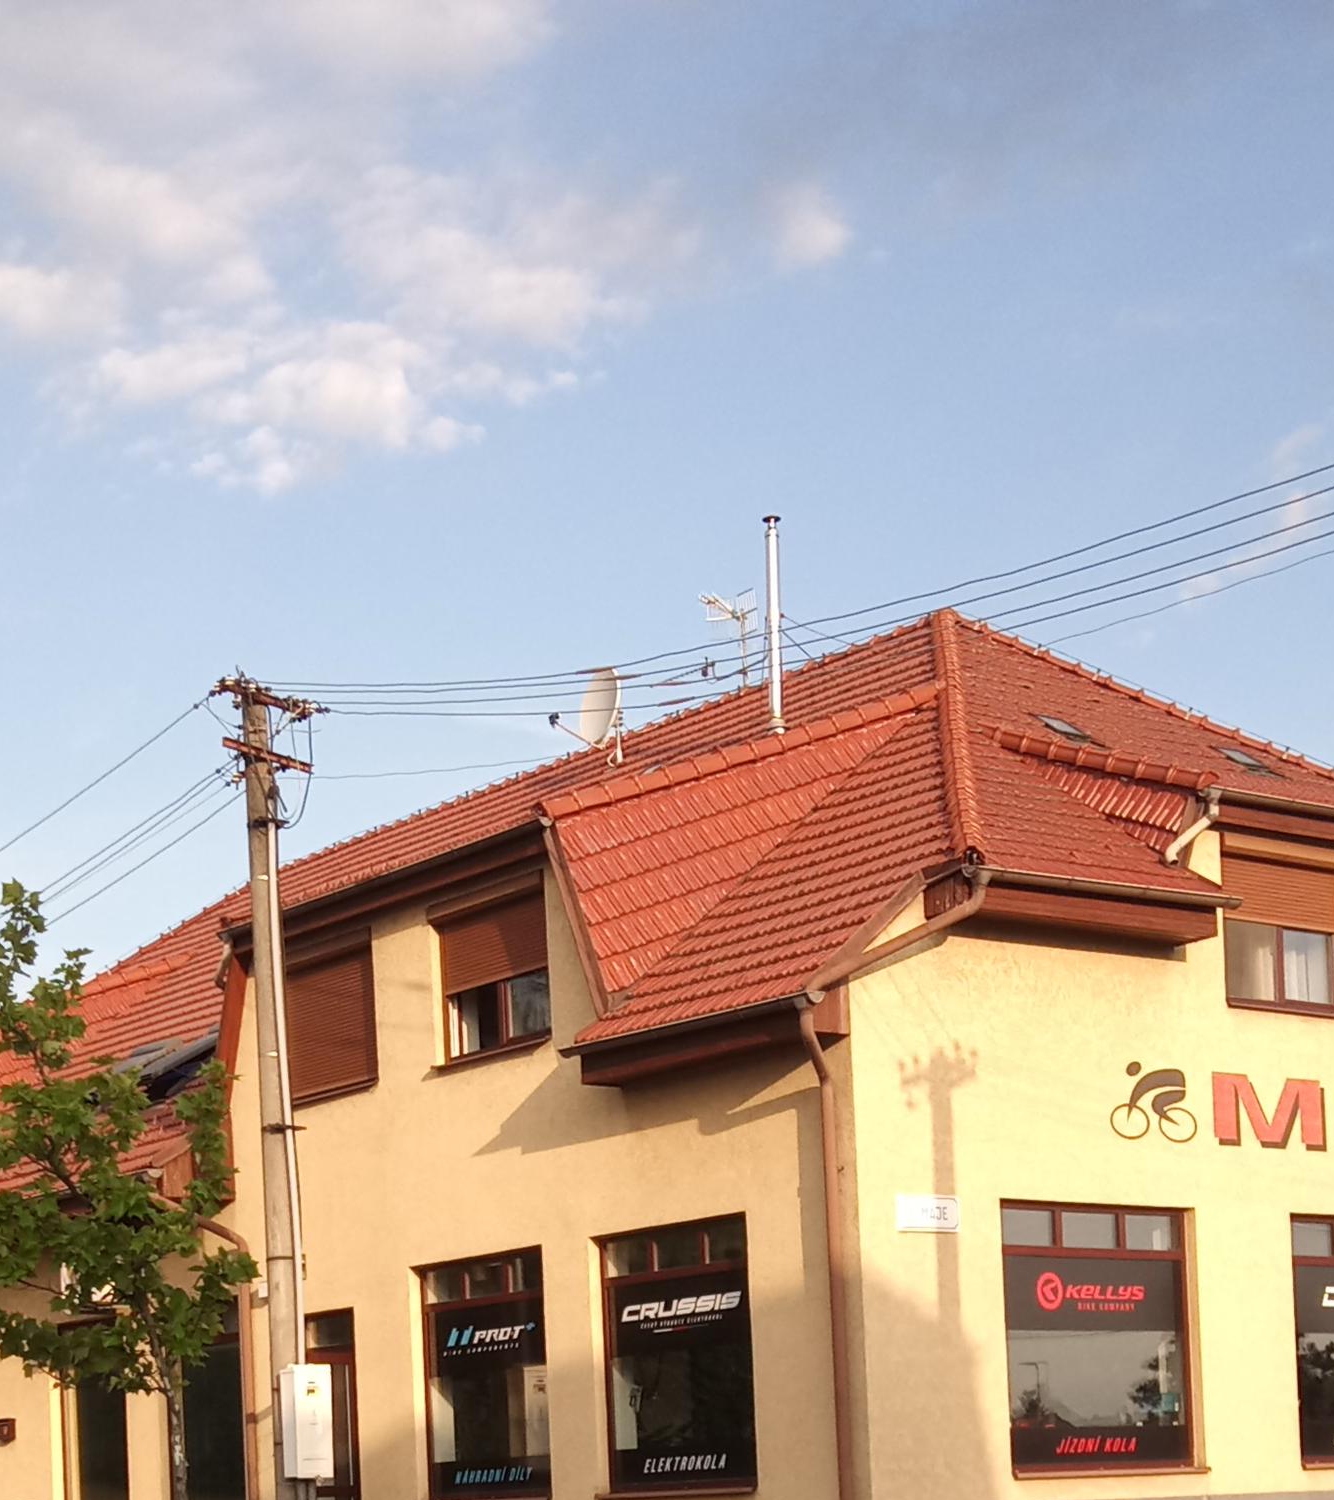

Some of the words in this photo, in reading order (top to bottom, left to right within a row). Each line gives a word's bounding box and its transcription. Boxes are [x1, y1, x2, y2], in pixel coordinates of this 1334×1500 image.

[1065, 1284, 1145, 1301] KELLYS
[621, 1290, 742, 1323] CRUSSIS
[1103, 1436, 1136, 1453] KOLA
[643, 1453, 727, 1474] ELEKTROKOLA
